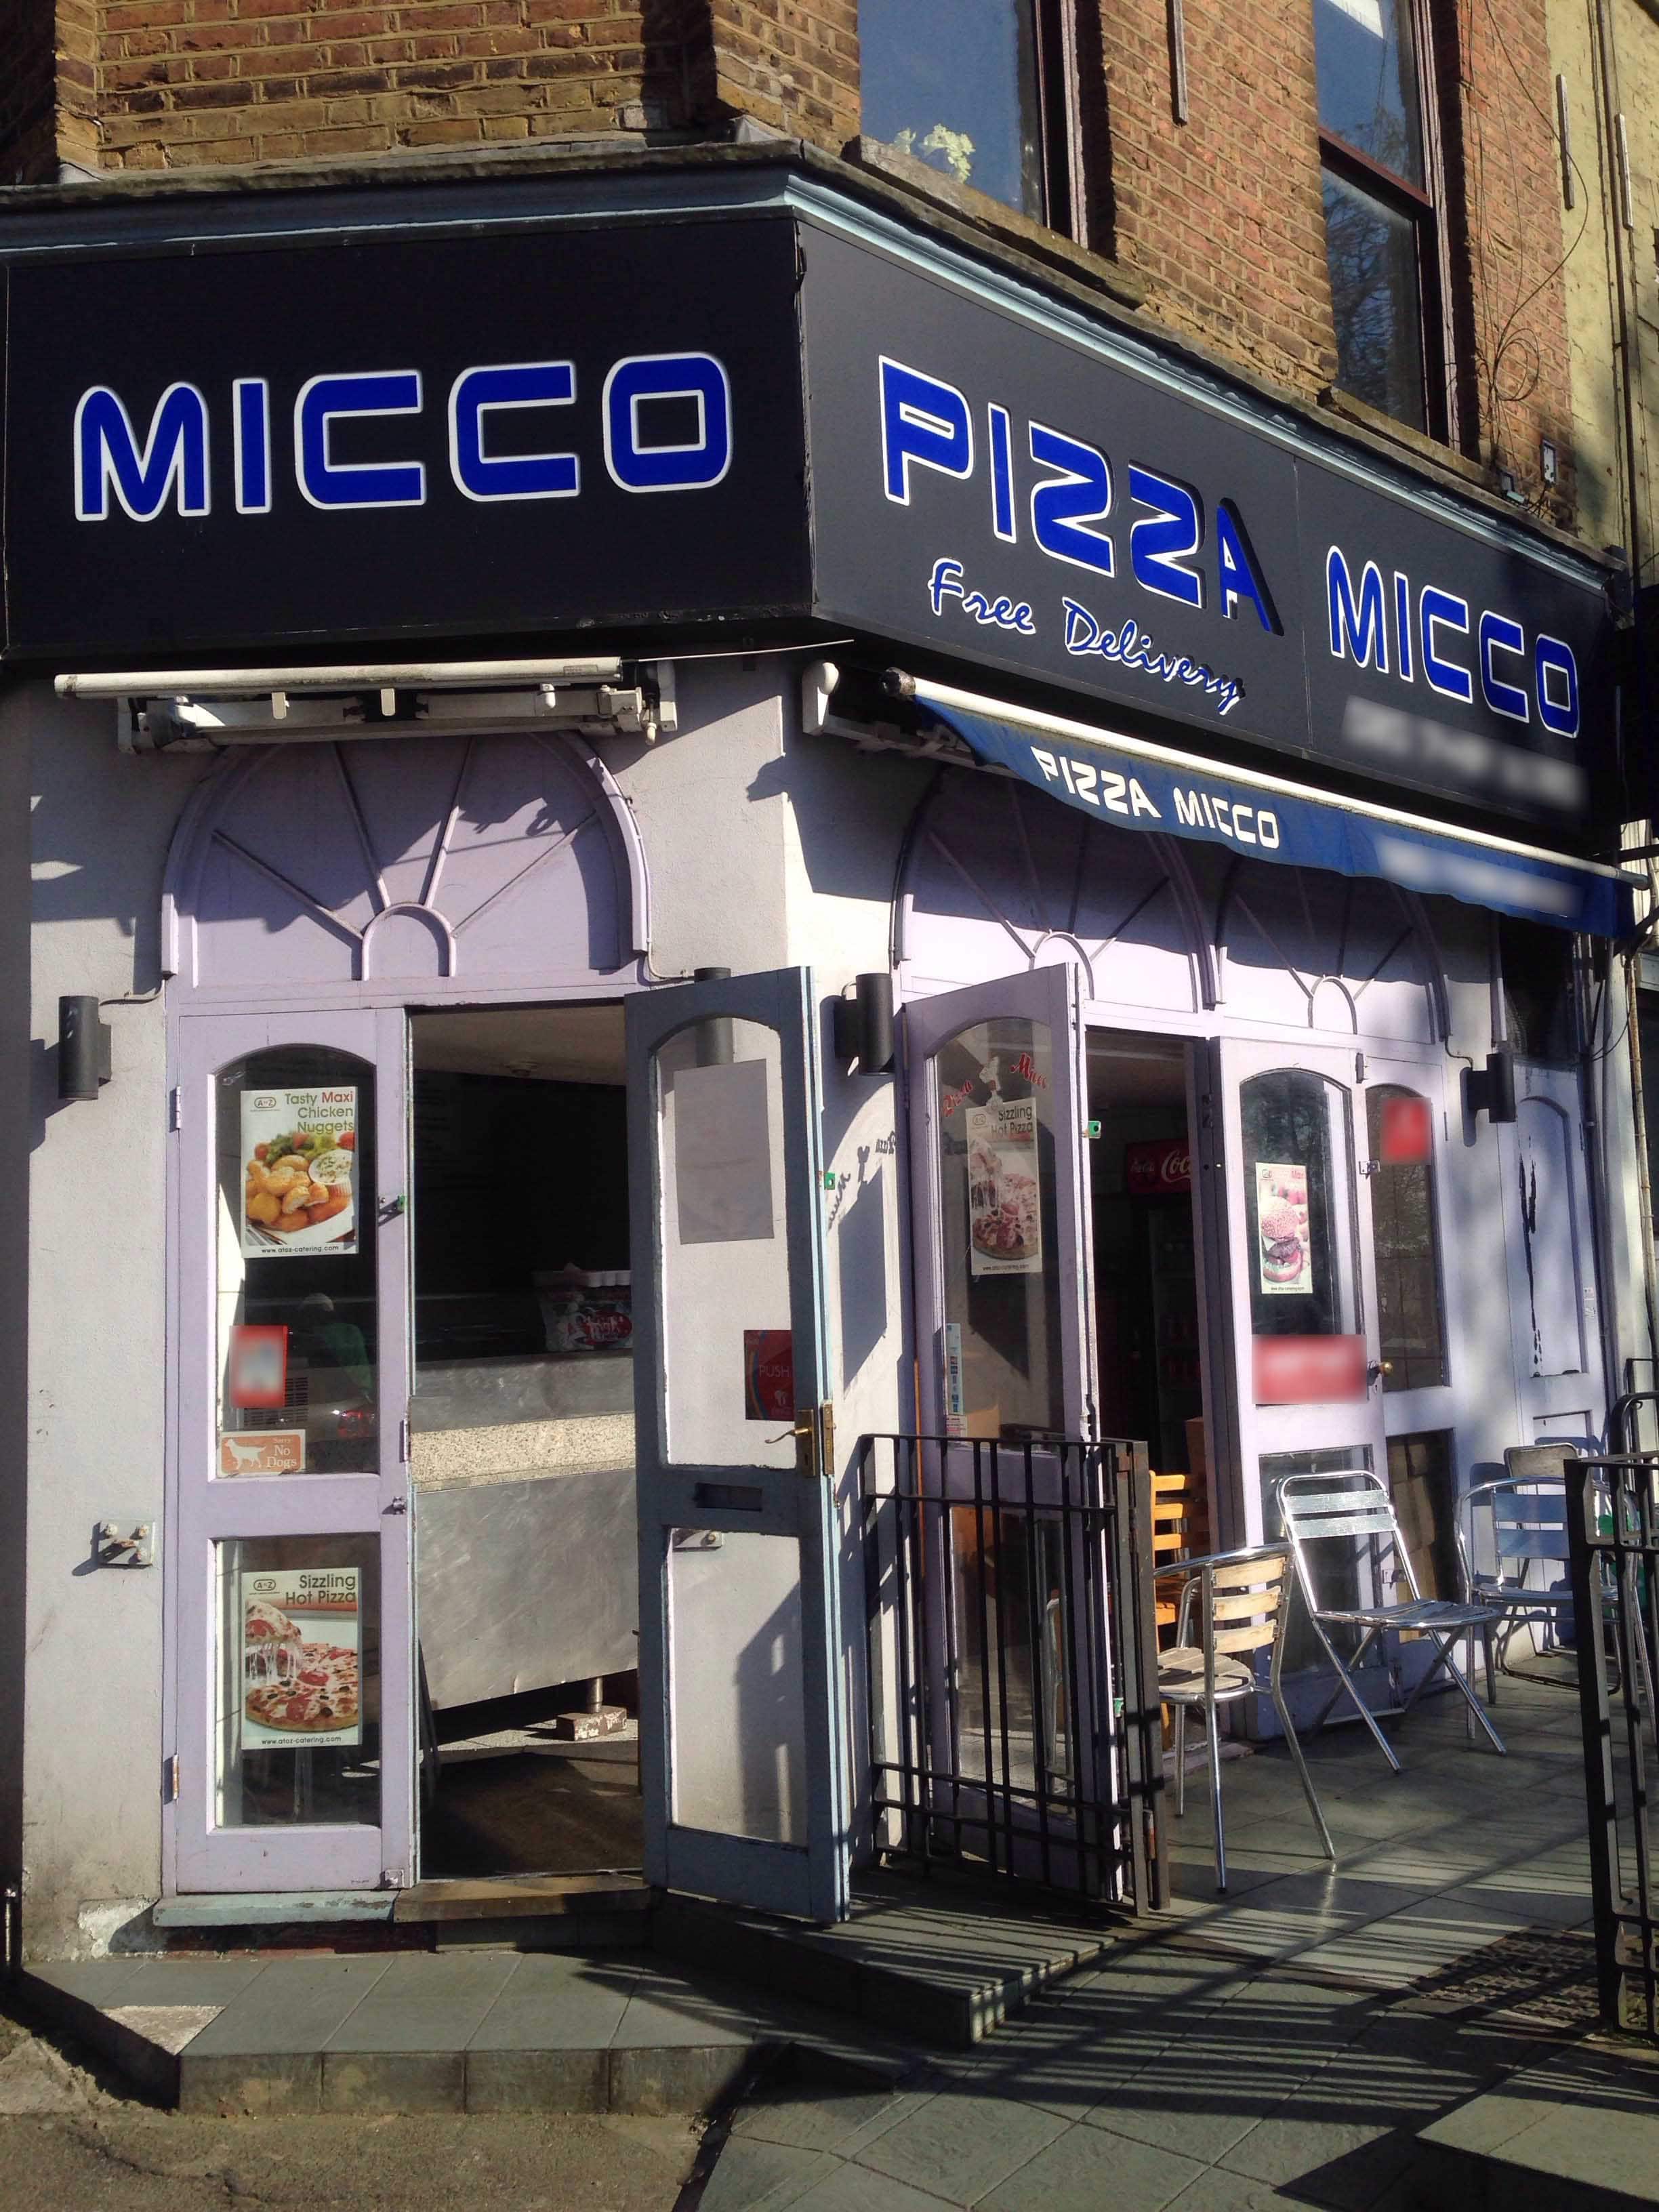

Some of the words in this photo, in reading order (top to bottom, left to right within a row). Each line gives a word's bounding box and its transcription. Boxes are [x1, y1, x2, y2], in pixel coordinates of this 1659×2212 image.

[73, 350, 733, 522] MICCO
[878, 354, 1282, 636] PIZZA
[1326, 545, 1580, 739] MICCO
[927, 557, 1037, 636] Free
[1061, 596, 1246, 716] Delivery
[1030, 745, 1162, 819] PIZZA
[1173, 787, 1279, 850] MICCO
[284, 1092, 317, 1107] Tasty
[321, 1090, 353, 1103] Maxi
[298, 1106, 354, 1119] Chicken
[998, 1105, 1033, 1122] Sizzling
[297, 1120, 354, 1134] Nuggets
[261, 1244, 339, 1254] www.atoz-catering.com
[758, 1365, 790, 1378] PUSH
[274, 1444, 291, 1456] No
[265, 1456, 297, 1469] Dogs
[299, 1574, 356, 1591] Sizzling
[285, 1591, 313, 1605] Hot
[318, 1590, 356, 1603] Pizza
[261, 1736, 342, 1745] www.atoz-catering.com
